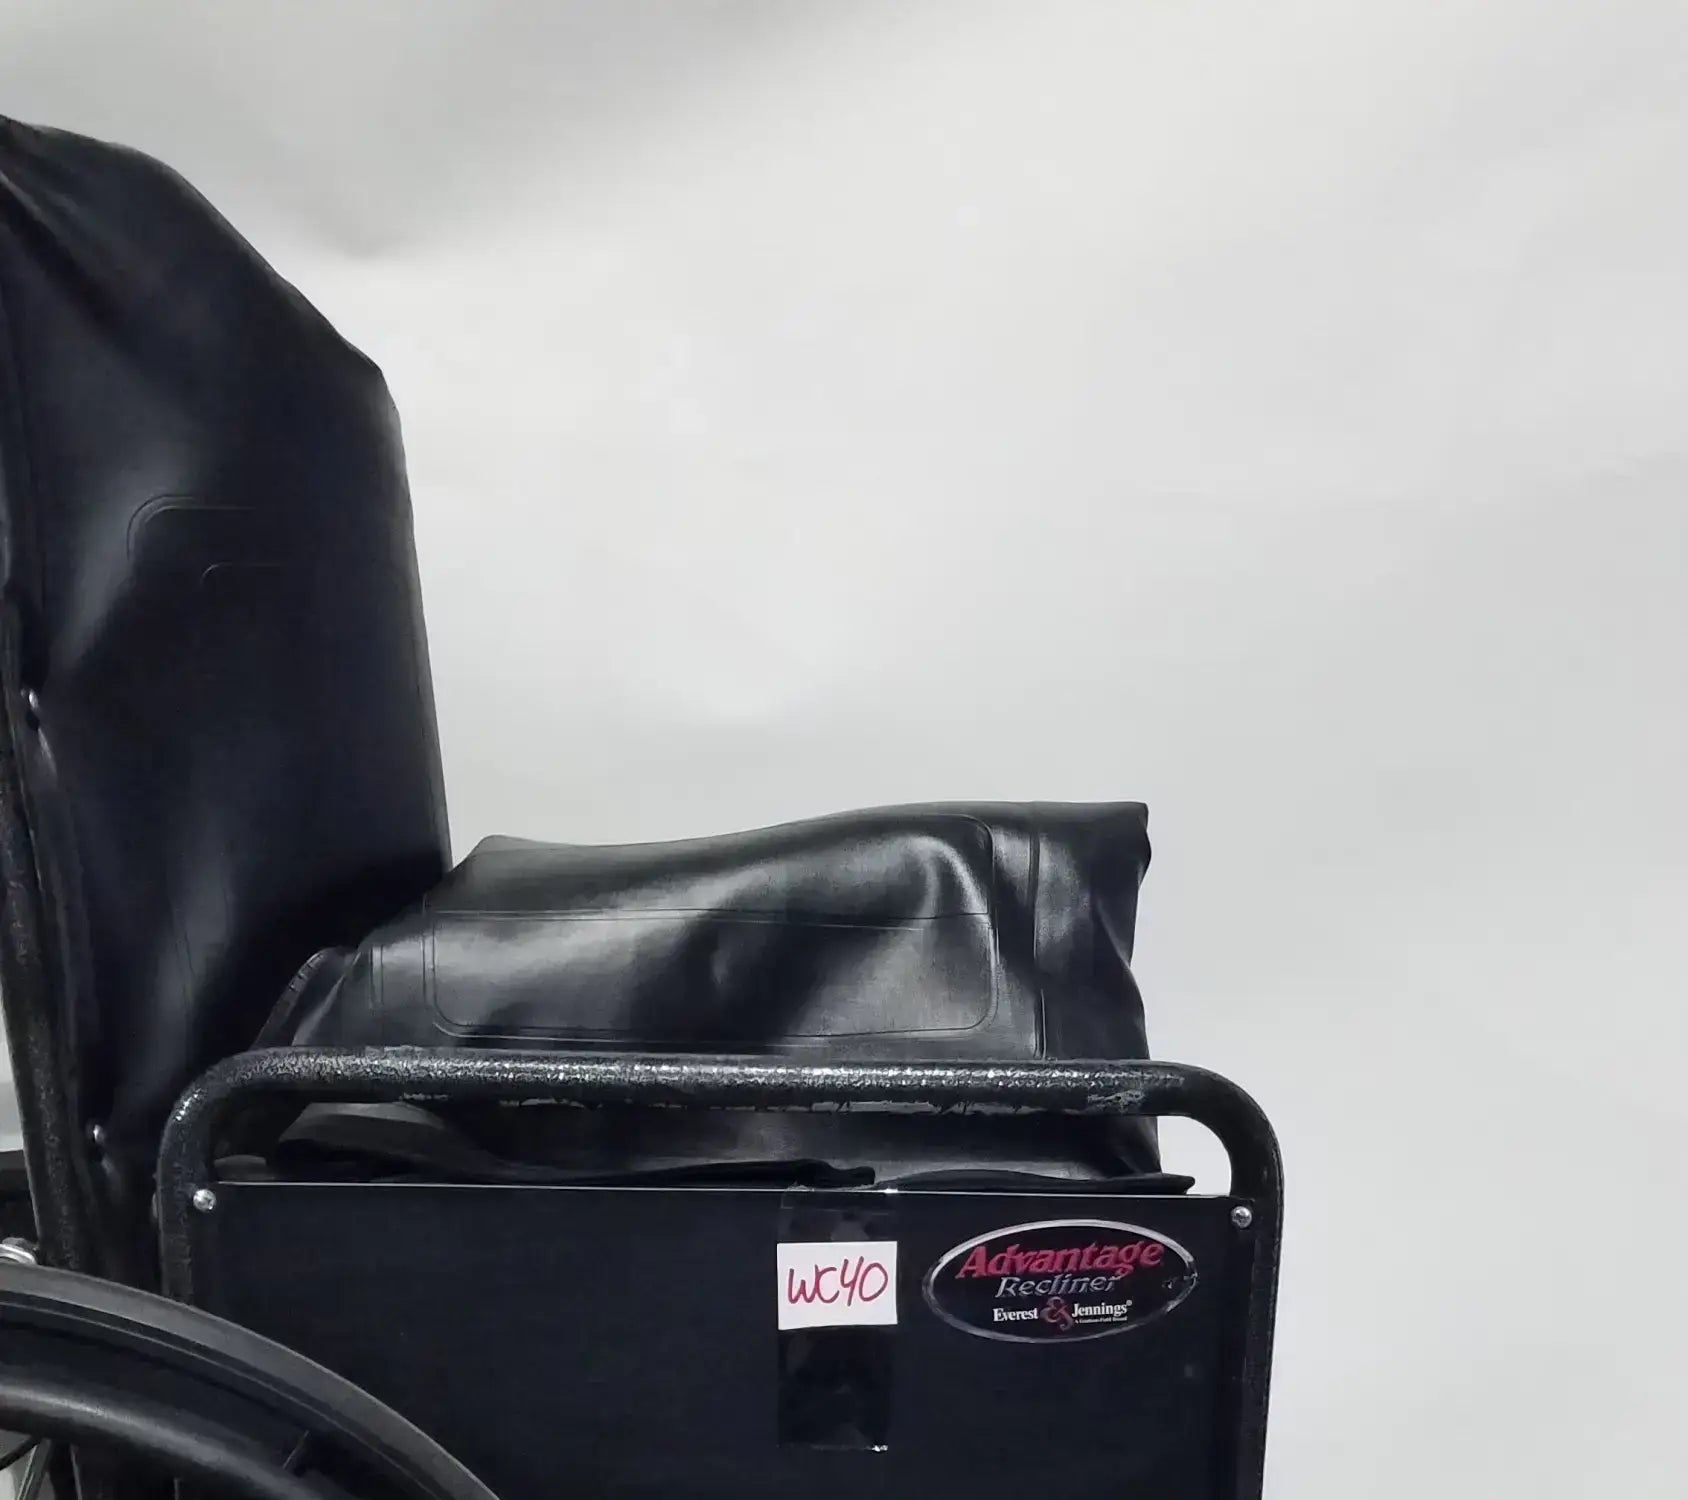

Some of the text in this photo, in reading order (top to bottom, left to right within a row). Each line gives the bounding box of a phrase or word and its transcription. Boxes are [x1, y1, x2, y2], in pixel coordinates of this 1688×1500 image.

[955, 1240, 1165, 1279] Advantage
[787, 1255, 889, 1307] WC40
[995, 1274, 1122, 1298] Recliner
[993, 1307, 1038, 1322] Everest
[1040, 1296, 1074, 1331] &
